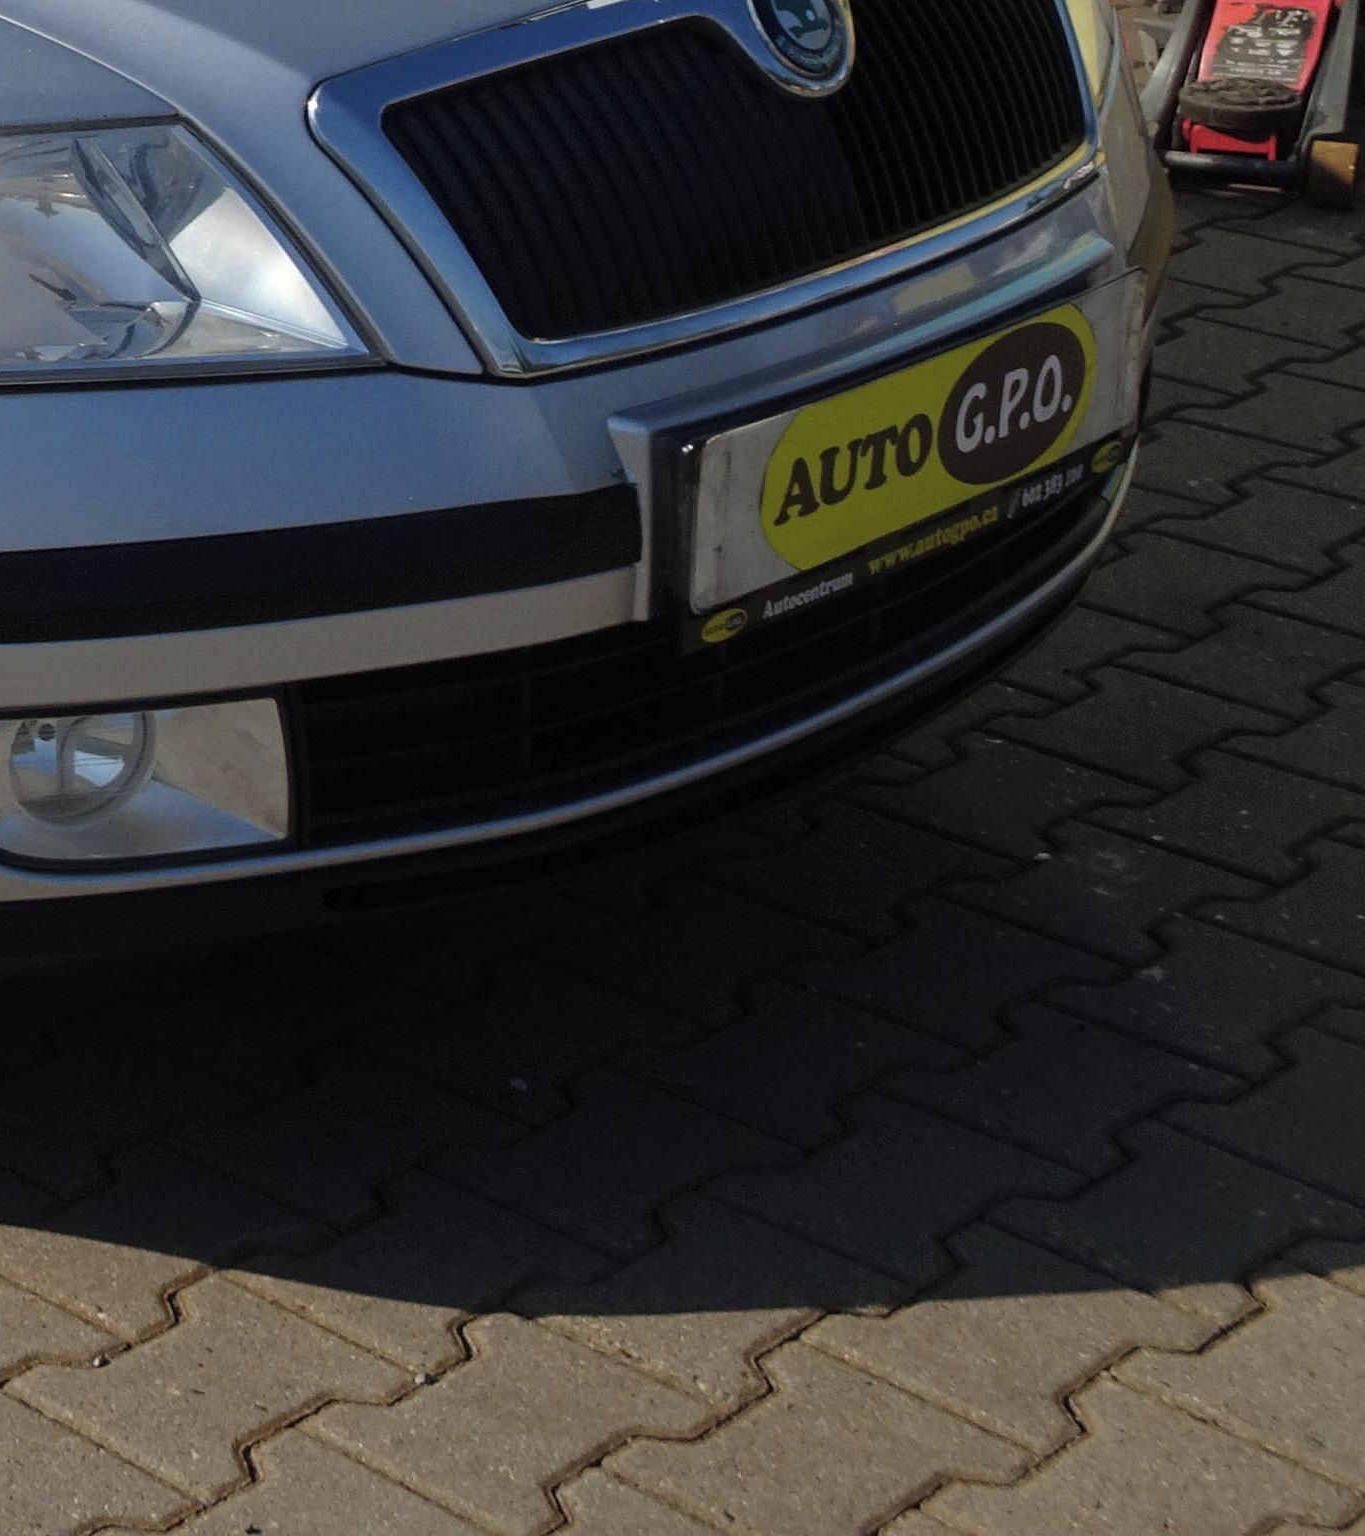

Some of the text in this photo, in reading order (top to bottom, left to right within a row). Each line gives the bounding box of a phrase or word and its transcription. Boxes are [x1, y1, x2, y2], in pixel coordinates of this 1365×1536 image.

[773, 354, 1073, 527] AUTO G.P.O.
[762, 571, 854, 620] Autocentrum
